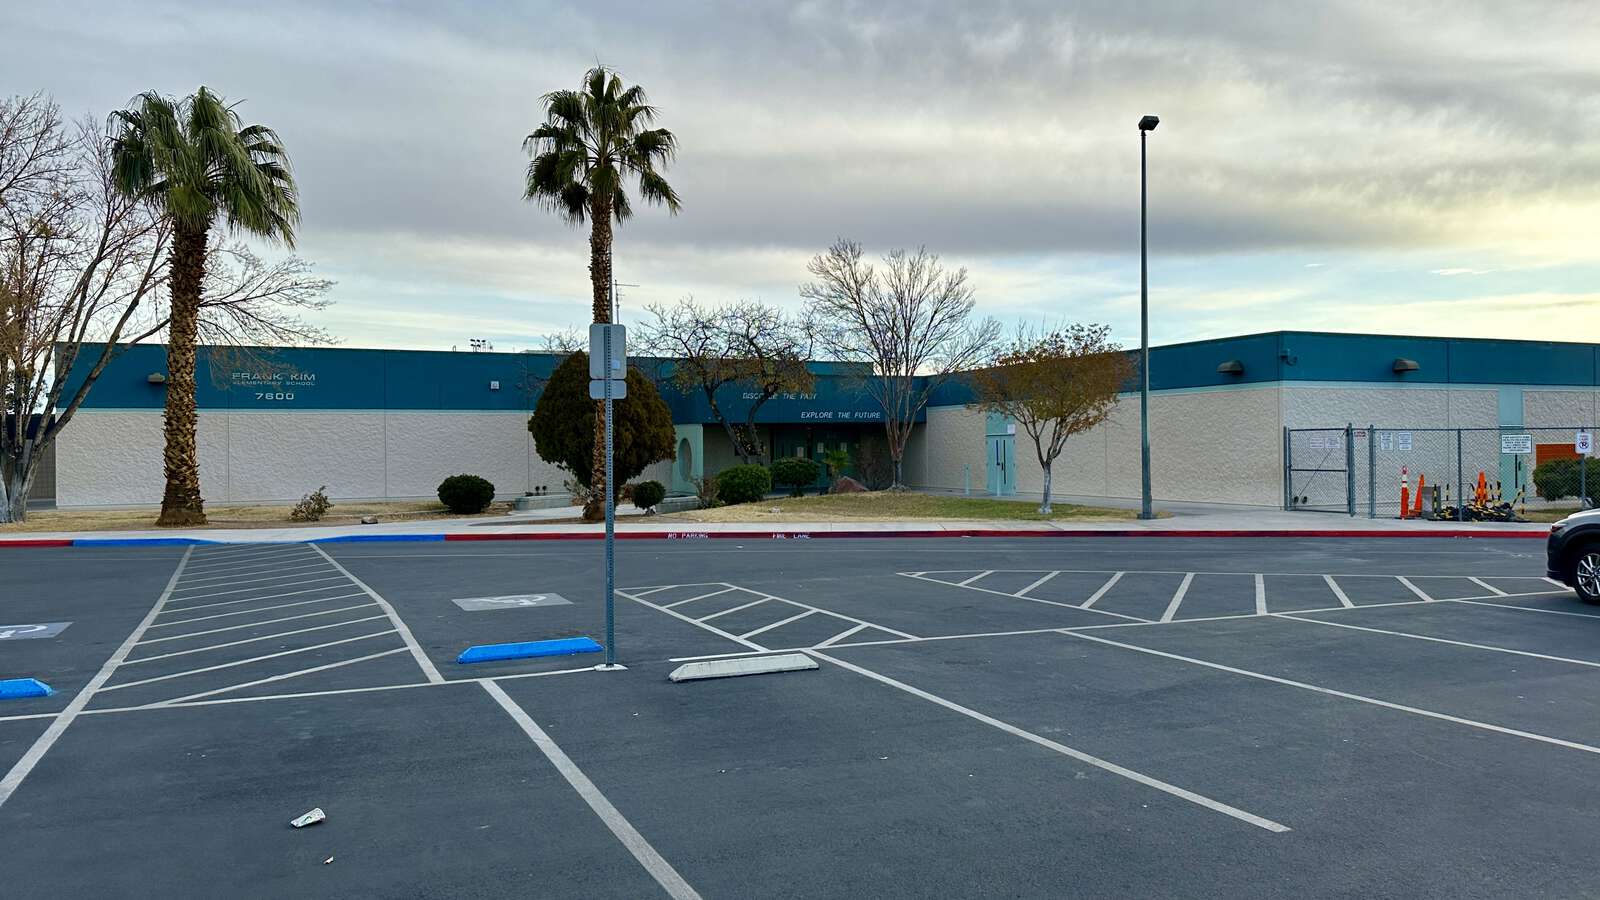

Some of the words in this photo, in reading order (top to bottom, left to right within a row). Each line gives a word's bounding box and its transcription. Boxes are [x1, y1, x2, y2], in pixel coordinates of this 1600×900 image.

[232, 372, 283, 380] FRANK
[255, 392, 295, 400] 7600
[742, 392, 778, 400] DISCER
[801, 411, 833, 419] EXPLORE
[837, 411, 851, 419] THE
[854, 411, 881, 419] FUTURE
